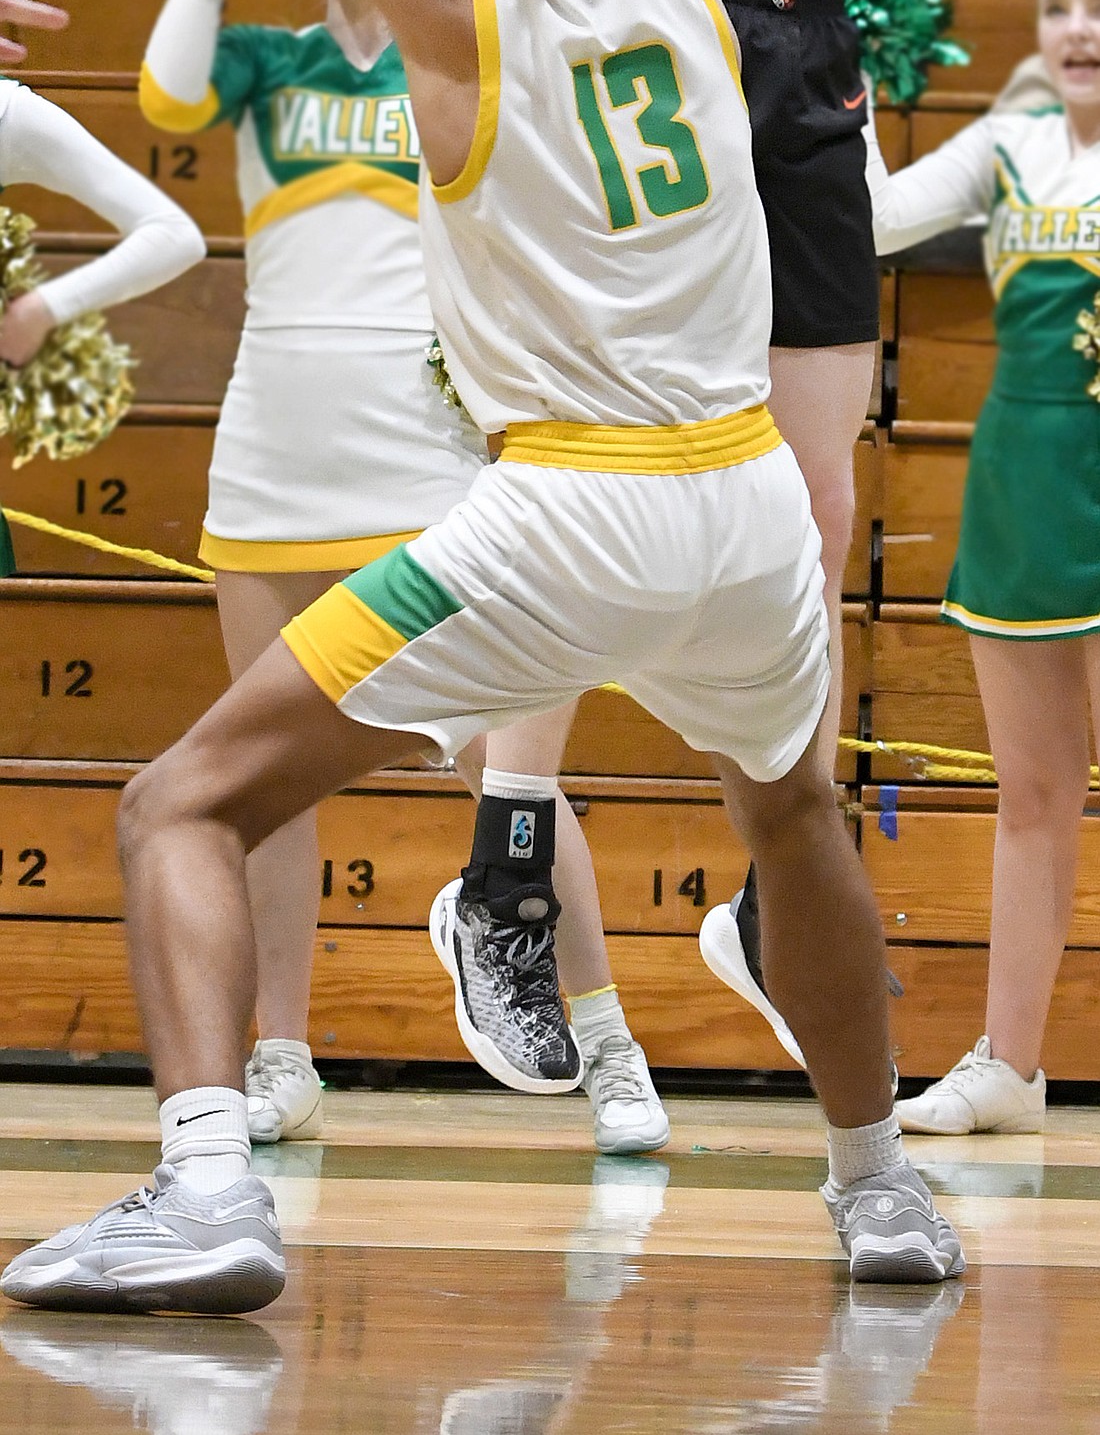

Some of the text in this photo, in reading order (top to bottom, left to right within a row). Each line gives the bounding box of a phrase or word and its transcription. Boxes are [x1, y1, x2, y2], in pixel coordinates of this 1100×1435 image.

[572, 39, 712, 234] 13
[150, 145, 198, 180] 12
[77, 478, 127, 514] 12
[41, 660, 93, 697] 12
[323, 859, 374, 898] 13
[653, 867, 706, 906] 14
